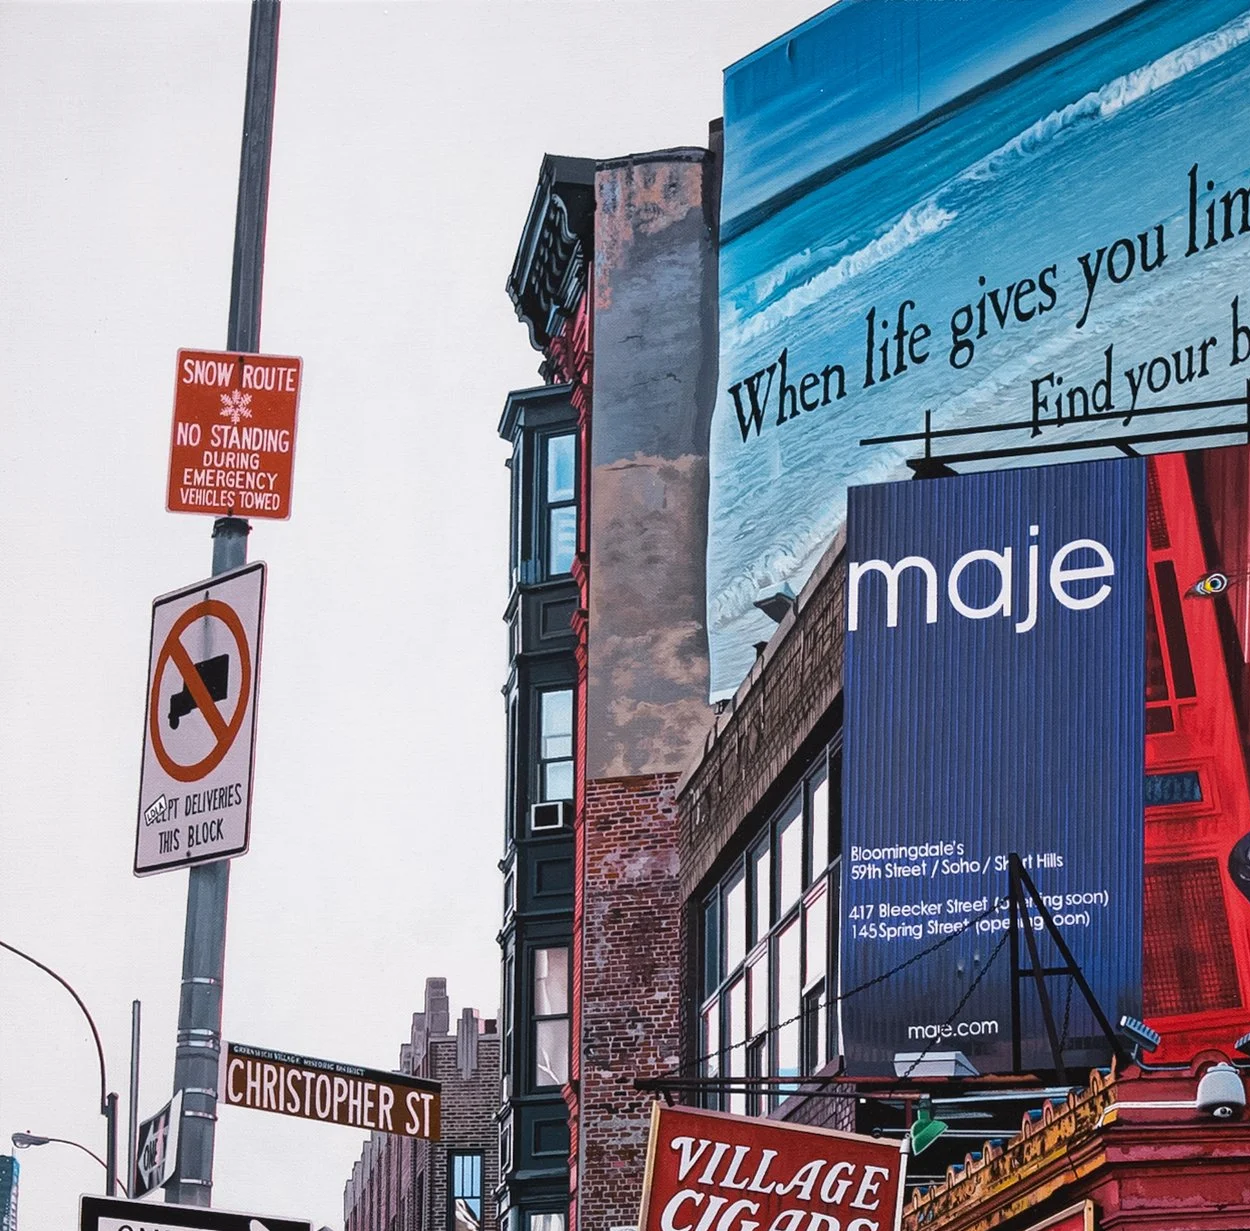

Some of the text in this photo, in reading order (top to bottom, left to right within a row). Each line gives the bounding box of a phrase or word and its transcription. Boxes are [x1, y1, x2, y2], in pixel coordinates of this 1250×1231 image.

[728, 347, 847, 444] When
[862, 300, 930, 388] life
[950, 262, 1058, 368] gives
[1076, 224, 1167, 329] you
[183, 359, 297, 392] SNOW ROUTE
[1029, 345, 1113, 438] Find
[1123, 335, 1217, 426] your
[177, 422, 289, 453] NO STANDING
[203, 451, 260, 470] DURING
[183, 468, 278, 490] EMERGENCY
[180, 488, 280, 511] VEHICLES TOWED
[848, 525, 1115, 633] maje
[185, 783, 242, 816] DELIVERIES
[158, 818, 224, 854] THIS BLOCK
[851, 841, 964, 863] Bloomingdale's
[851, 864, 882, 880] 59th
[885, 861, 927, 877] Street
[941, 858, 980, 875] Soho
[994, 854, 1033, 871] Shrt
[1037, 852, 1064, 868] Hills
[849, 905, 873, 920] 417
[879, 900, 942, 919] Bleecker
[946, 898, 988, 914] Street
[1066, 890, 1109, 908] soon)
[851, 923, 877, 939] 145
[879, 921, 922, 940] Spring
[926, 918, 970, 936] Street
[1053, 910, 1090, 928] oon)
[908, 1018, 998, 1043] maje.com
[227, 1058, 434, 1137] CHRISTOPHER ST
[671, 1136, 890, 1210] VILLAGE
